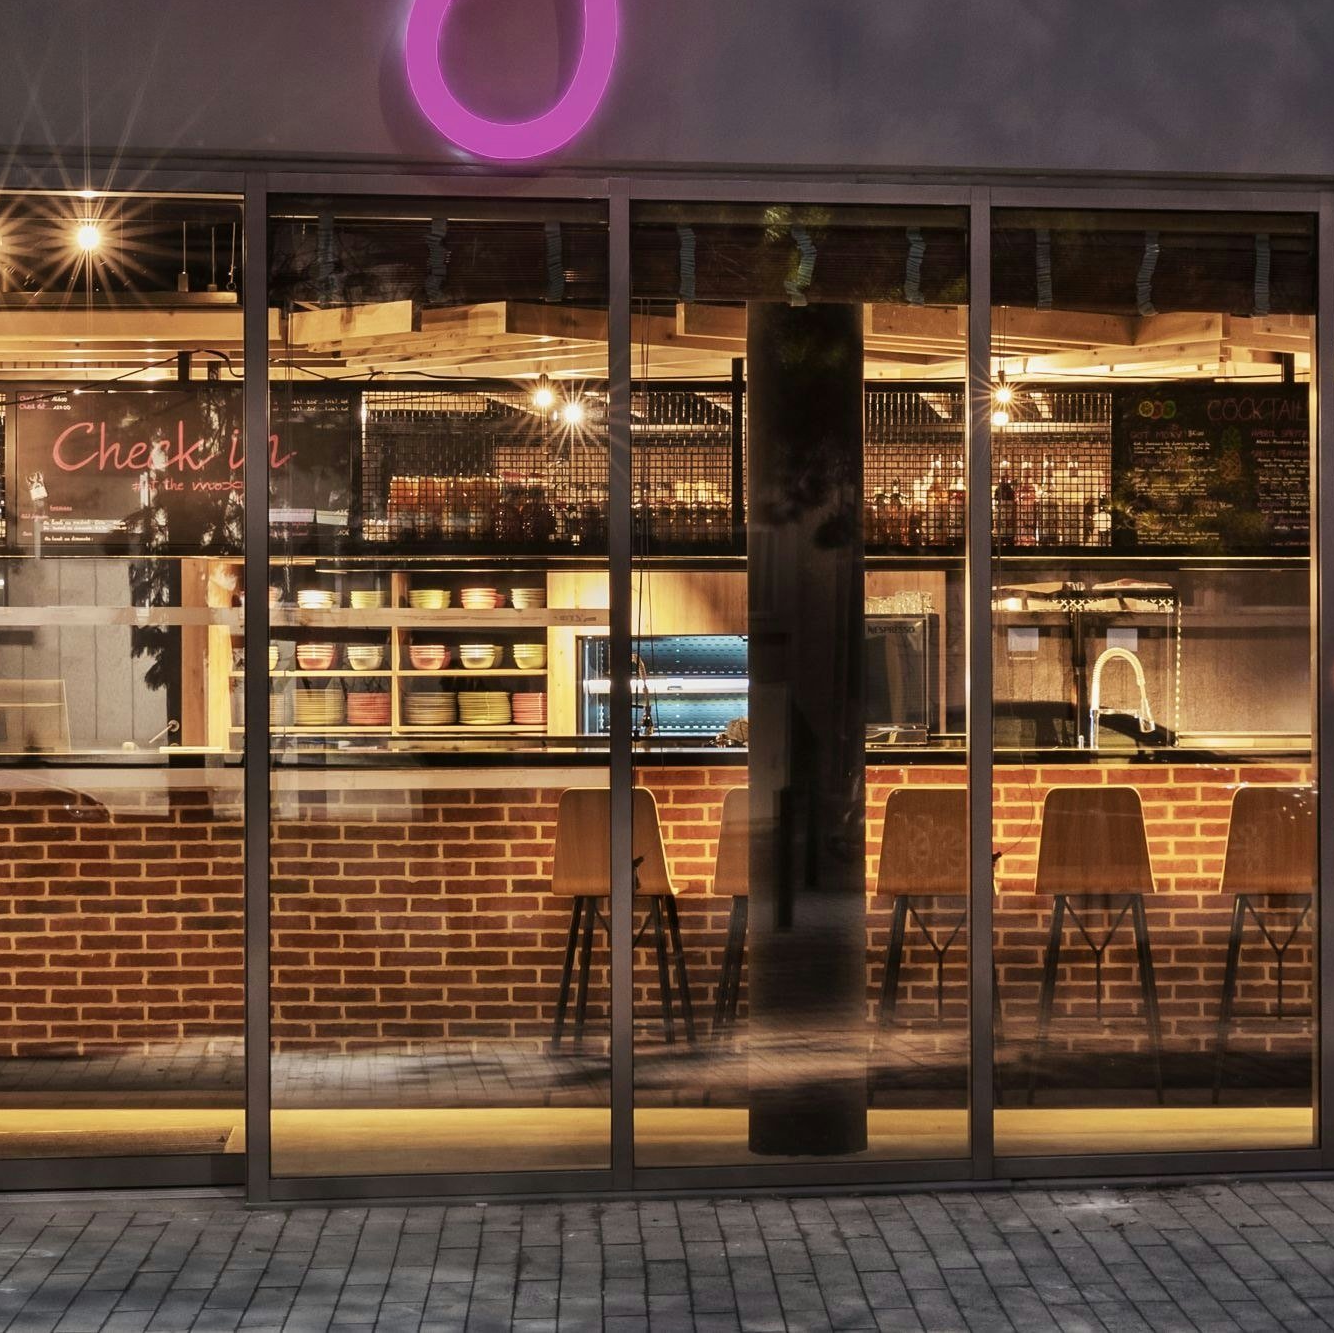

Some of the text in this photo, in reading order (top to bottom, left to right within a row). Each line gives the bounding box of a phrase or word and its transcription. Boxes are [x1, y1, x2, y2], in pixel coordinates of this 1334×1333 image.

[52, 420, 223, 472] Check
[163, 477, 184, 491] the
[192, 481, 244, 491] mox
[867, 625, 915, 634] NESPRESSO
